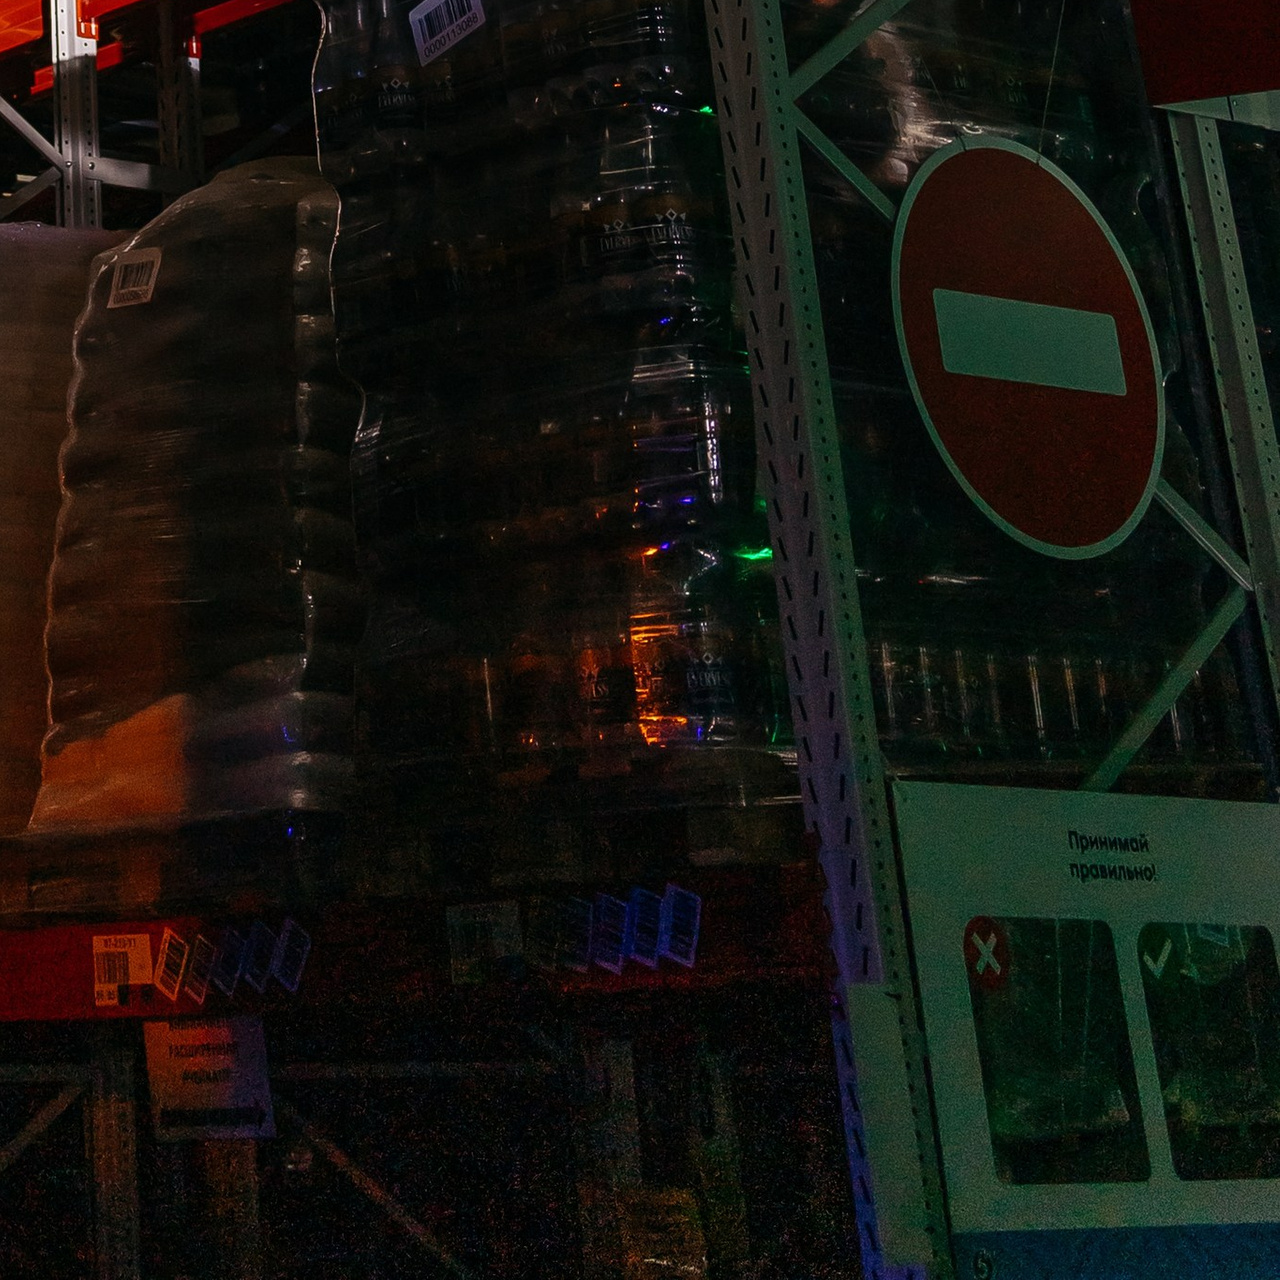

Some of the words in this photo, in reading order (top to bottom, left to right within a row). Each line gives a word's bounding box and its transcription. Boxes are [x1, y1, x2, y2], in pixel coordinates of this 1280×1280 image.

[423, 12, 479, 58] 0000113088
[1068, 830, 1149, 854] Принимай
[1069, 863, 1157, 883] правильно!
